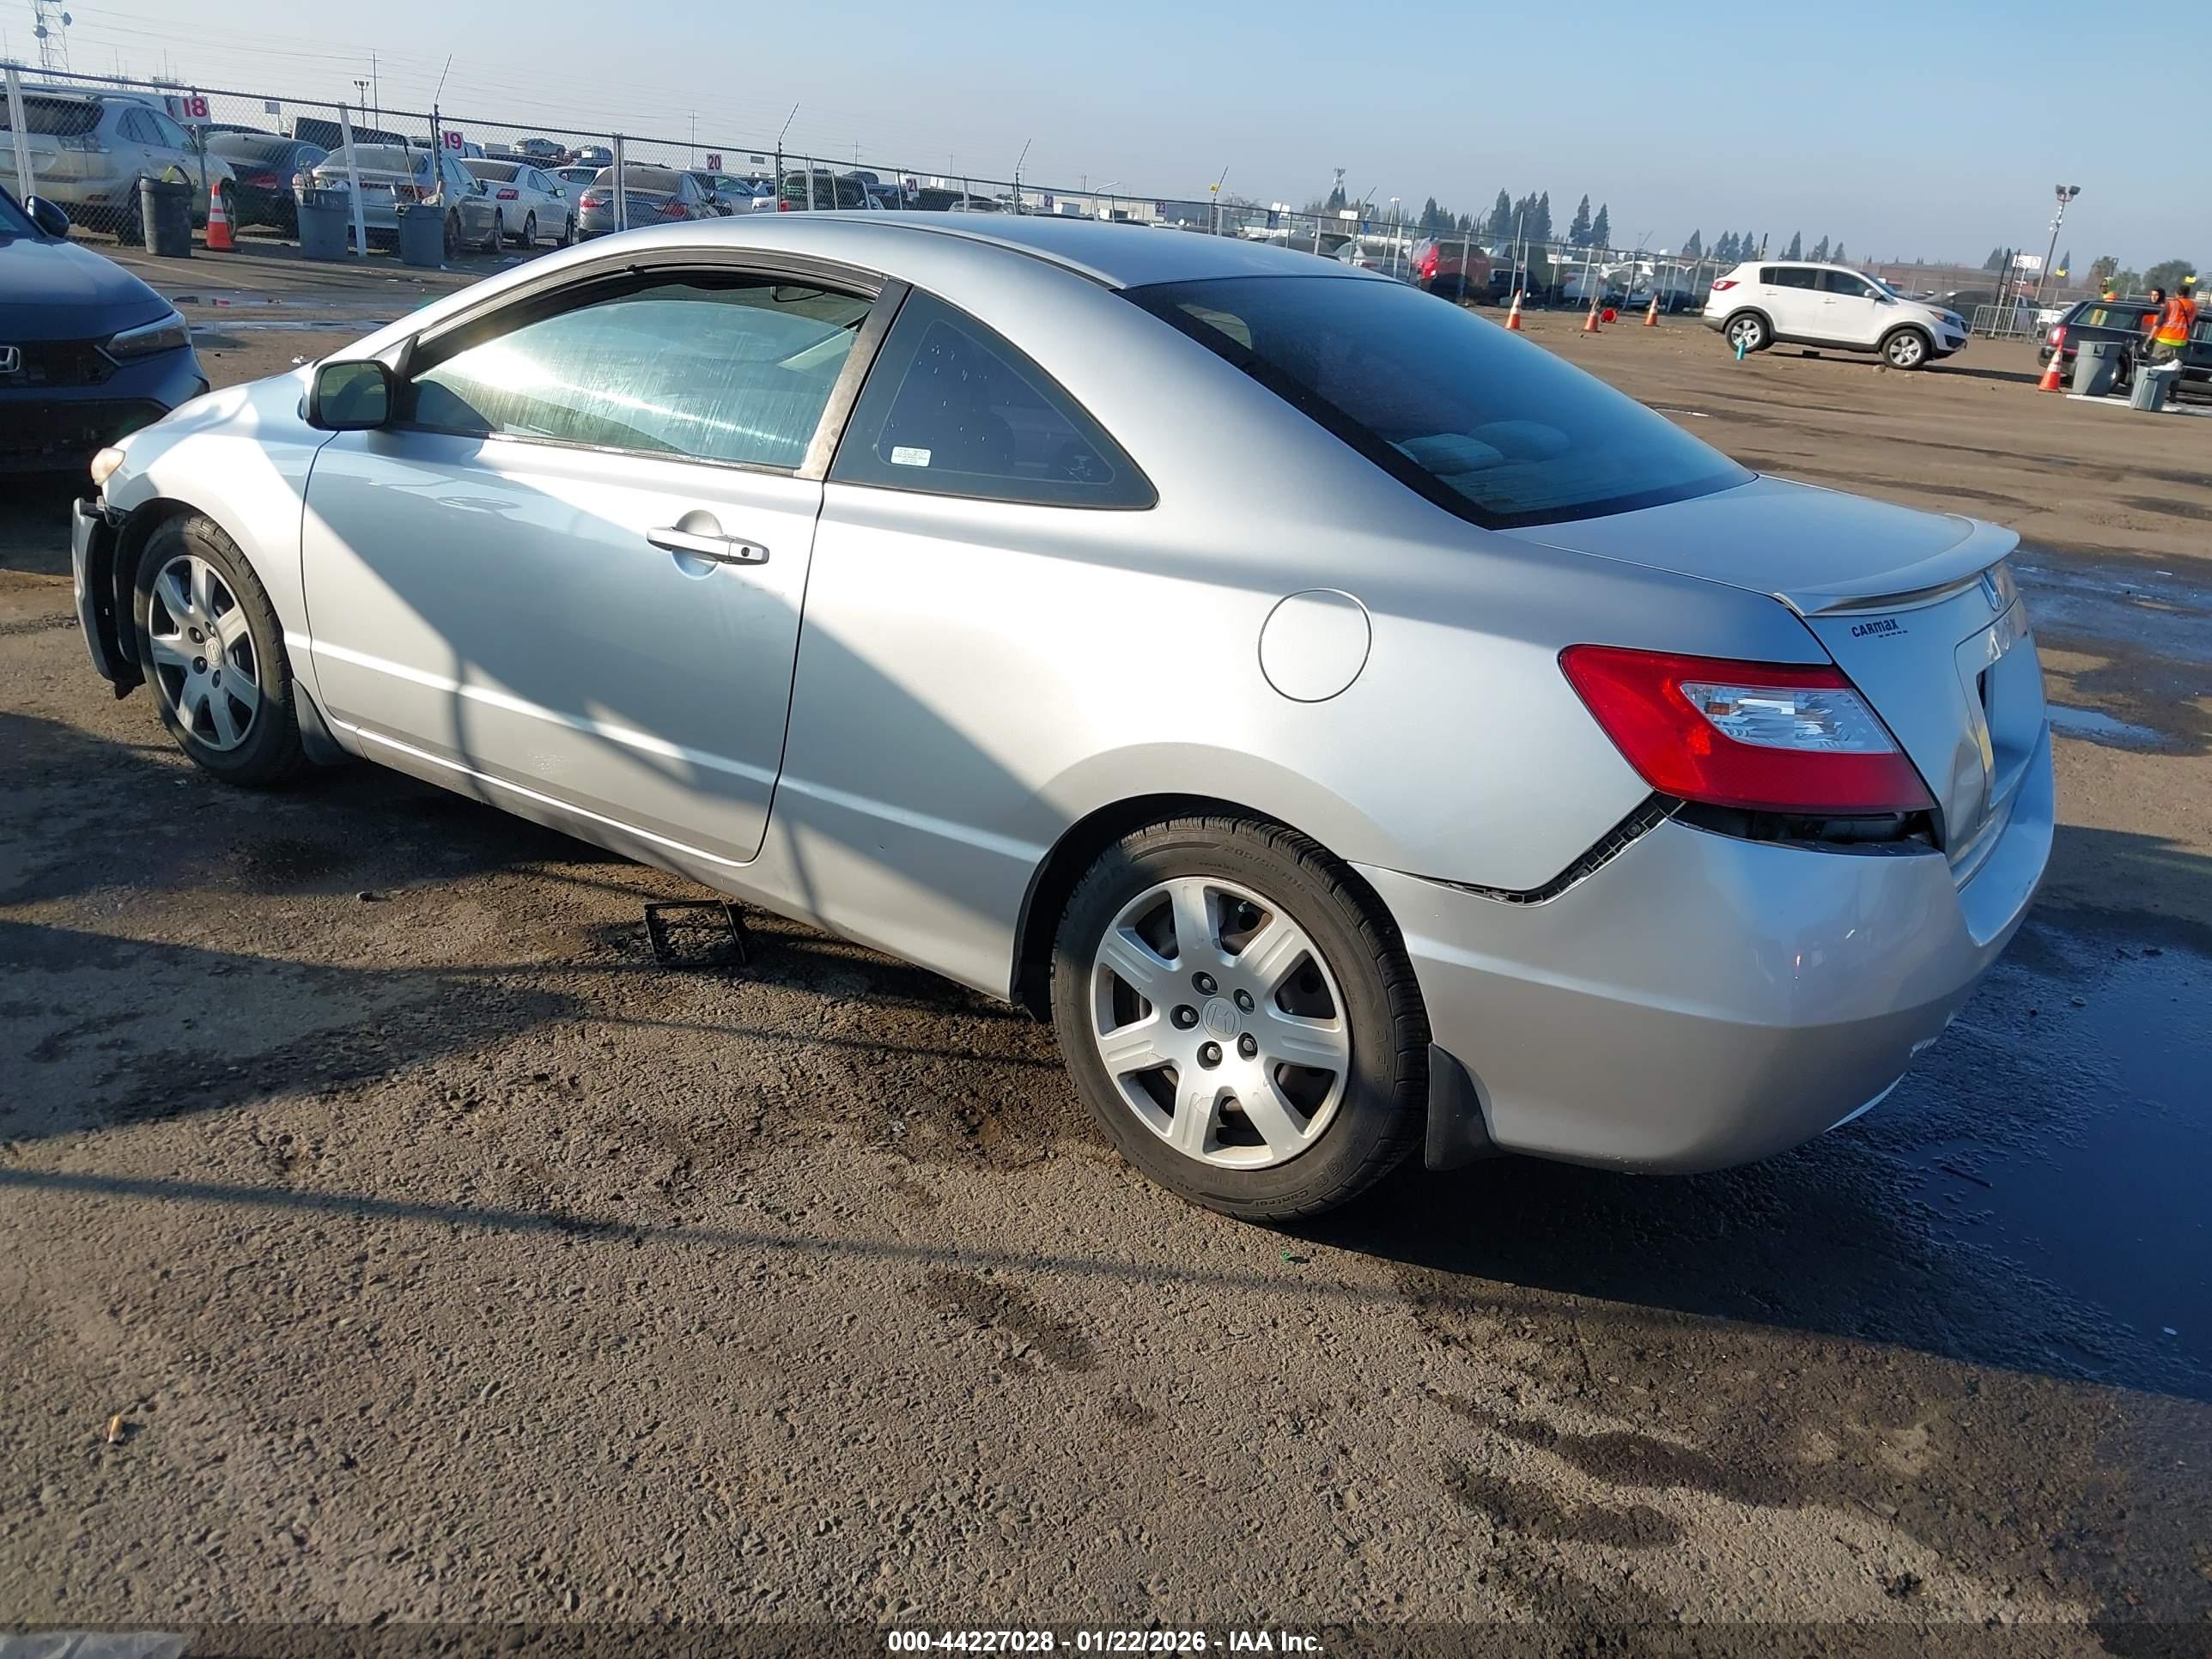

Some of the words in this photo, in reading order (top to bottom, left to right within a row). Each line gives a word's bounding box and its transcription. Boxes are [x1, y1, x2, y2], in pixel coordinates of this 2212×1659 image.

[182, 98, 208, 118] 18
[444, 131, 462, 149] 19
[708, 155, 721, 170] 20
[907, 178, 918, 192] 21
[1044, 195, 1054, 208] 22
[1156, 202, 1166, 214] 23
